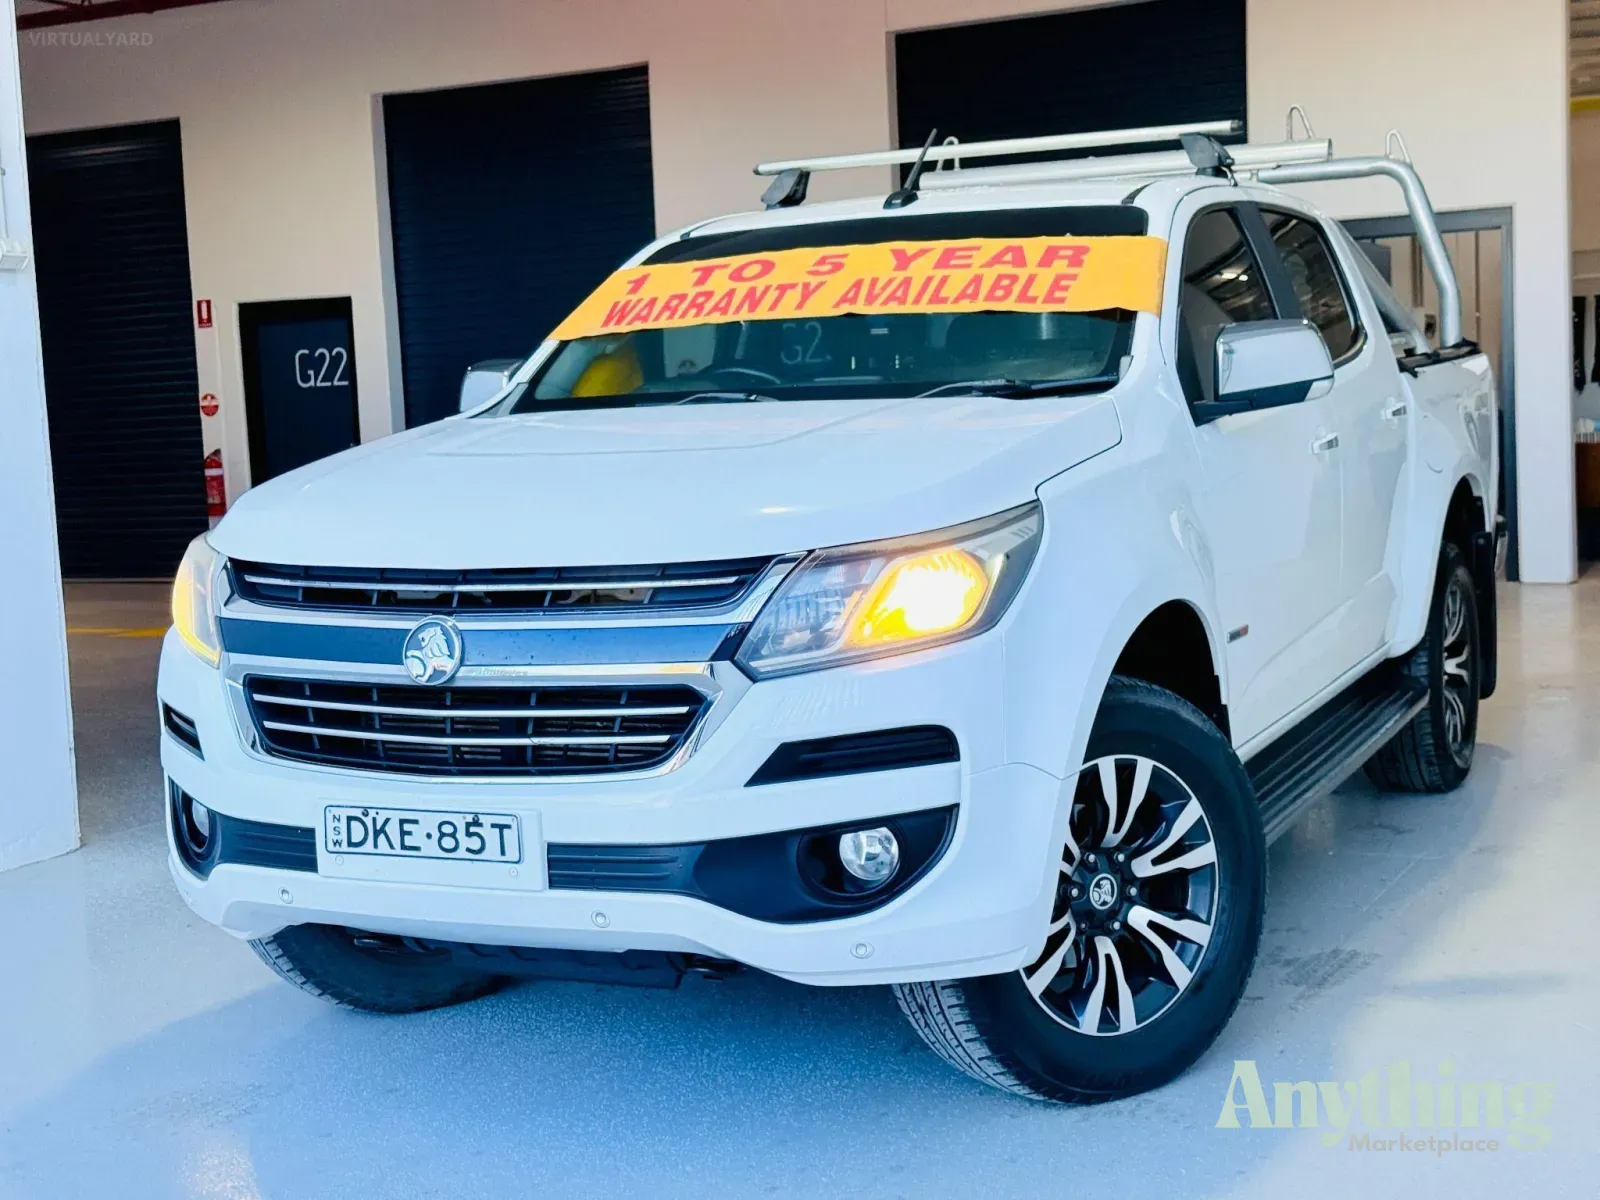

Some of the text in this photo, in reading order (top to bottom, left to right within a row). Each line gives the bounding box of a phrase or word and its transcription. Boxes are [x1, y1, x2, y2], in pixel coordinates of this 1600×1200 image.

[627, 244, 1091, 295] 1 TO 5 YEAR
[600, 272, 1078, 328] WARRANTY AVAILABLE
[295, 347, 349, 388] G22
[332, 814, 343, 848] NSW
